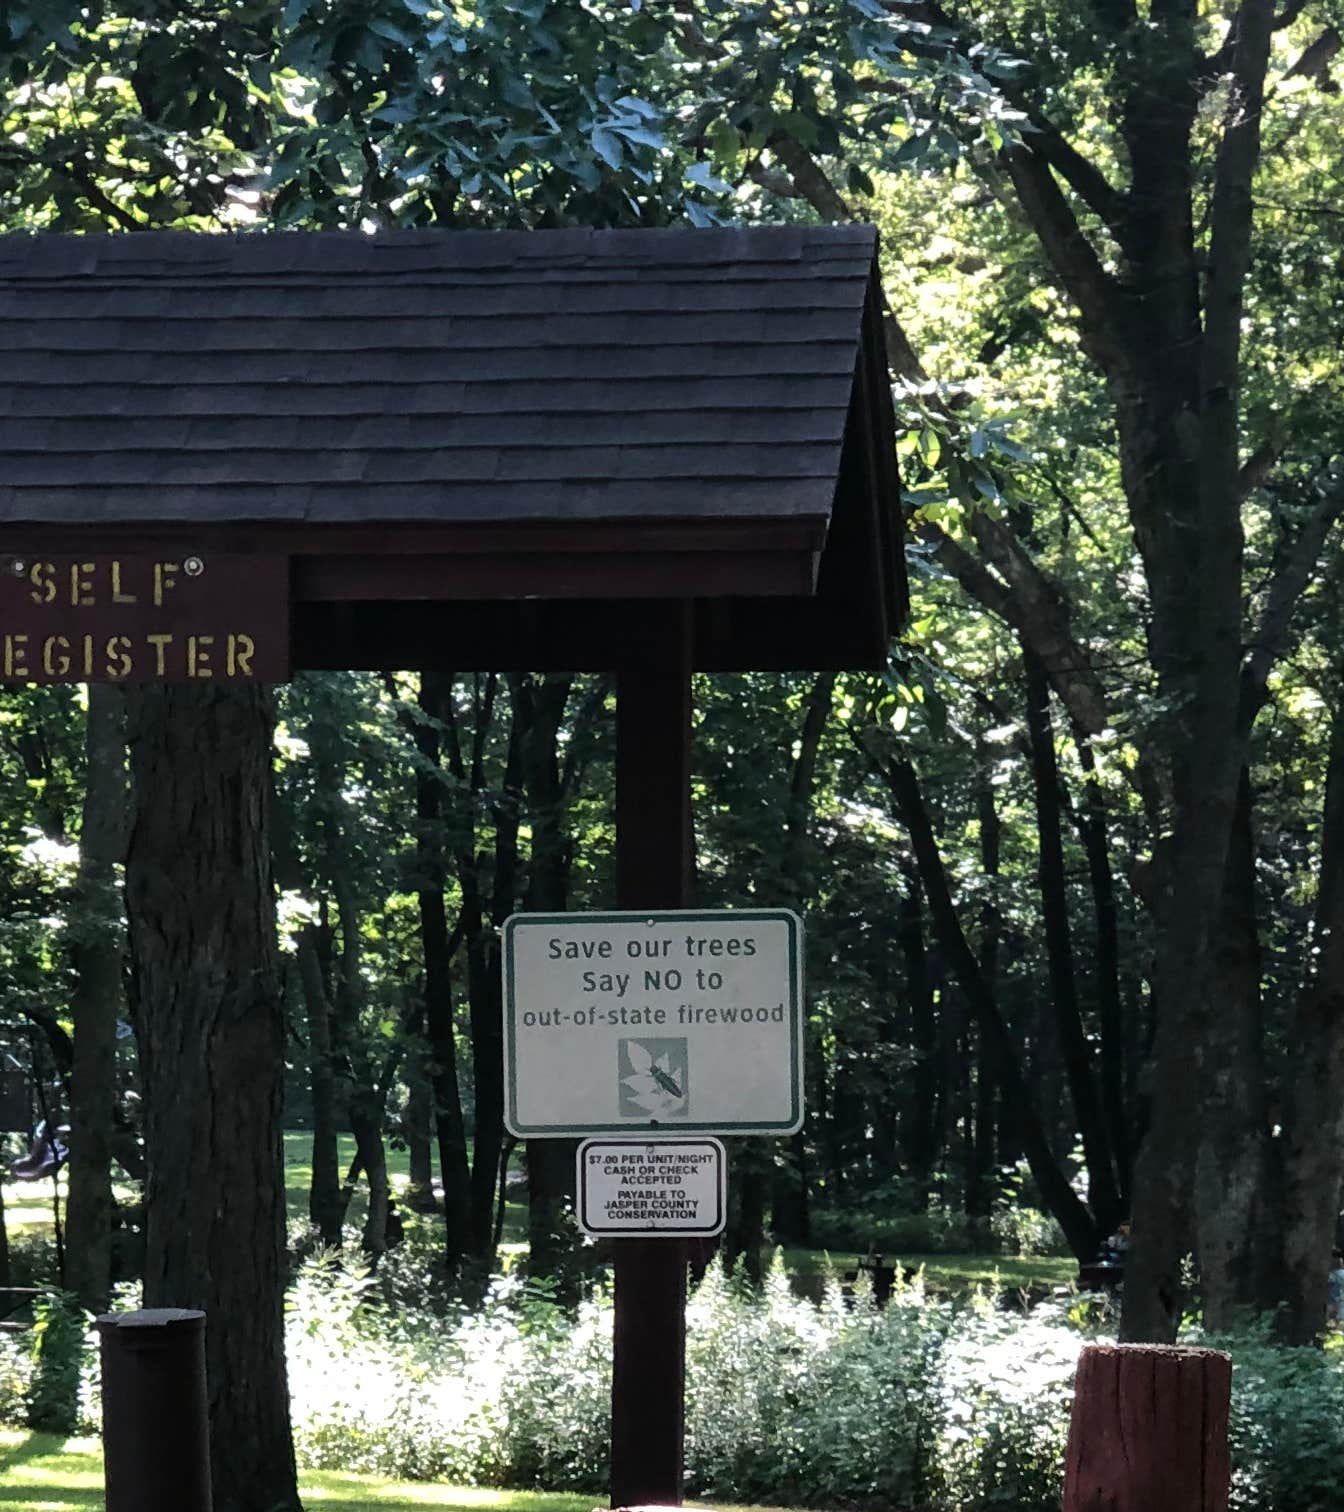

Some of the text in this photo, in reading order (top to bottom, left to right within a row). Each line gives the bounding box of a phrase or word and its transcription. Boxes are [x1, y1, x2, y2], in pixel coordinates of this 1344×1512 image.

[29, 560, 180, 607] SELF
[549, 936, 757, 960] Save our trees
[583, 969, 724, 998] Say NO to
[523, 1003, 785, 1027] out-of-state firewood
[621, 1154, 644, 1164] PER
[604, 1166, 699, 1175] CASH OR CHECK
[621, 1176, 682, 1185] ACCEPTED
[617, 1190, 686, 1200] PAYABLE TO
[603, 1200, 699, 1210] JASPER COUNTY
[607, 1210, 697, 1220] CONSERVATION
